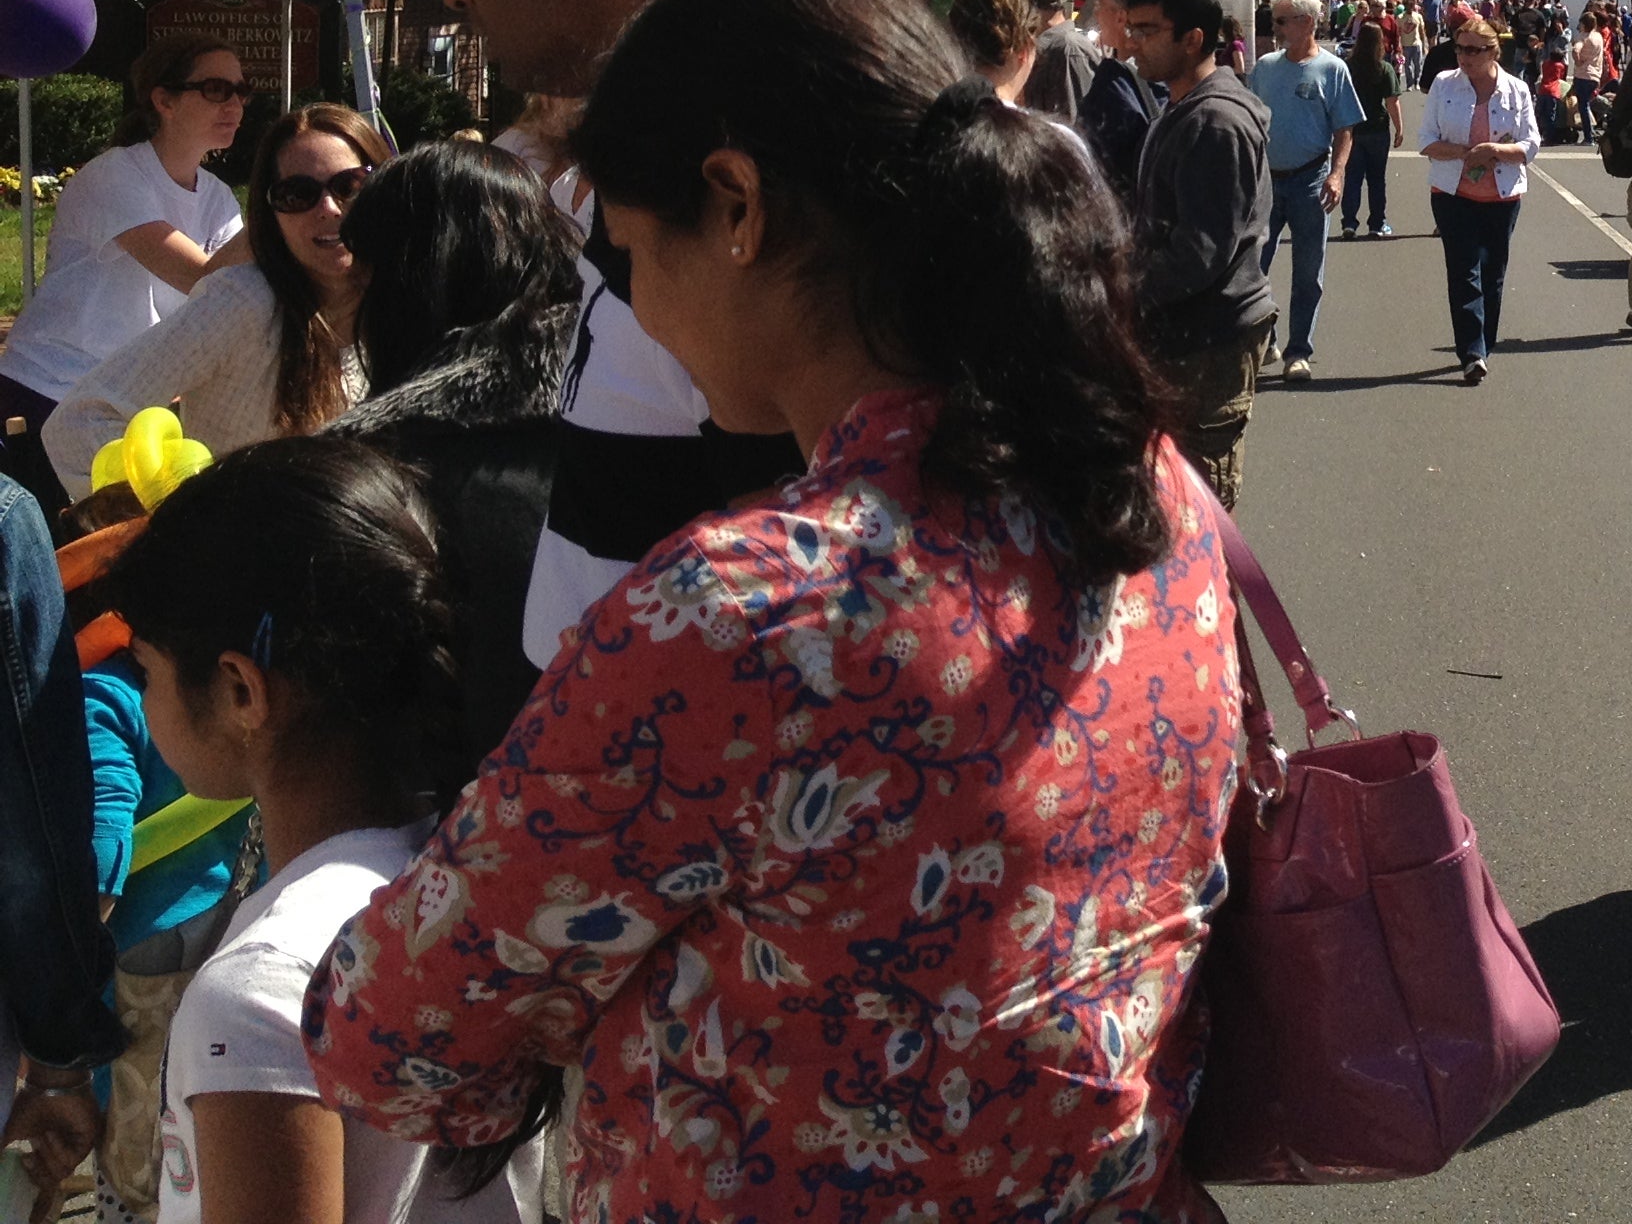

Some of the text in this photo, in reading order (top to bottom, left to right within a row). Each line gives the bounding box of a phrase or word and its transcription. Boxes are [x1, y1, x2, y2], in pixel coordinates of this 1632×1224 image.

[174, 12, 206, 23] LAW
[208, 12, 271, 24] OFFICES
[227, 27, 314, 43] BERKOTZ
